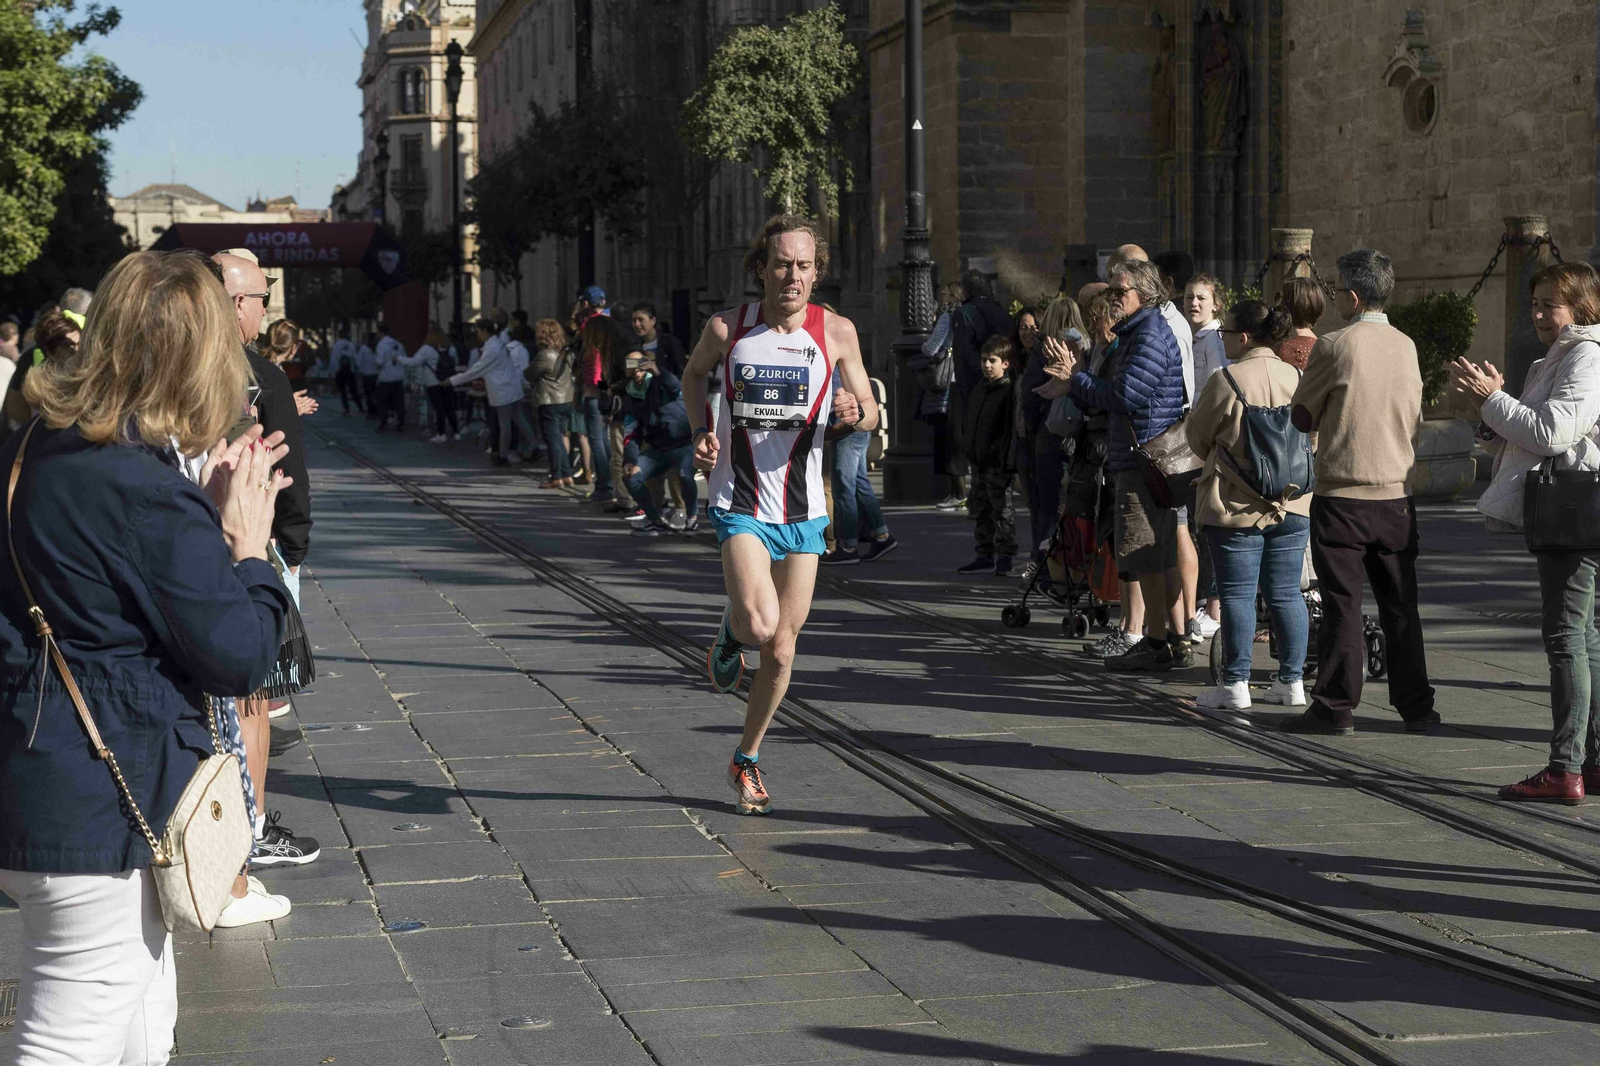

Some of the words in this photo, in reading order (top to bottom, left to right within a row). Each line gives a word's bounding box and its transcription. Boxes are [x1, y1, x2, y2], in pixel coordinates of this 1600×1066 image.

[244, 232, 310, 246] AHORA
[274, 247, 339, 261] RINDAS
[758, 369, 800, 380] ZURICH
[763, 389, 778, 400] 86
[754, 407, 784, 416] EKVALL
